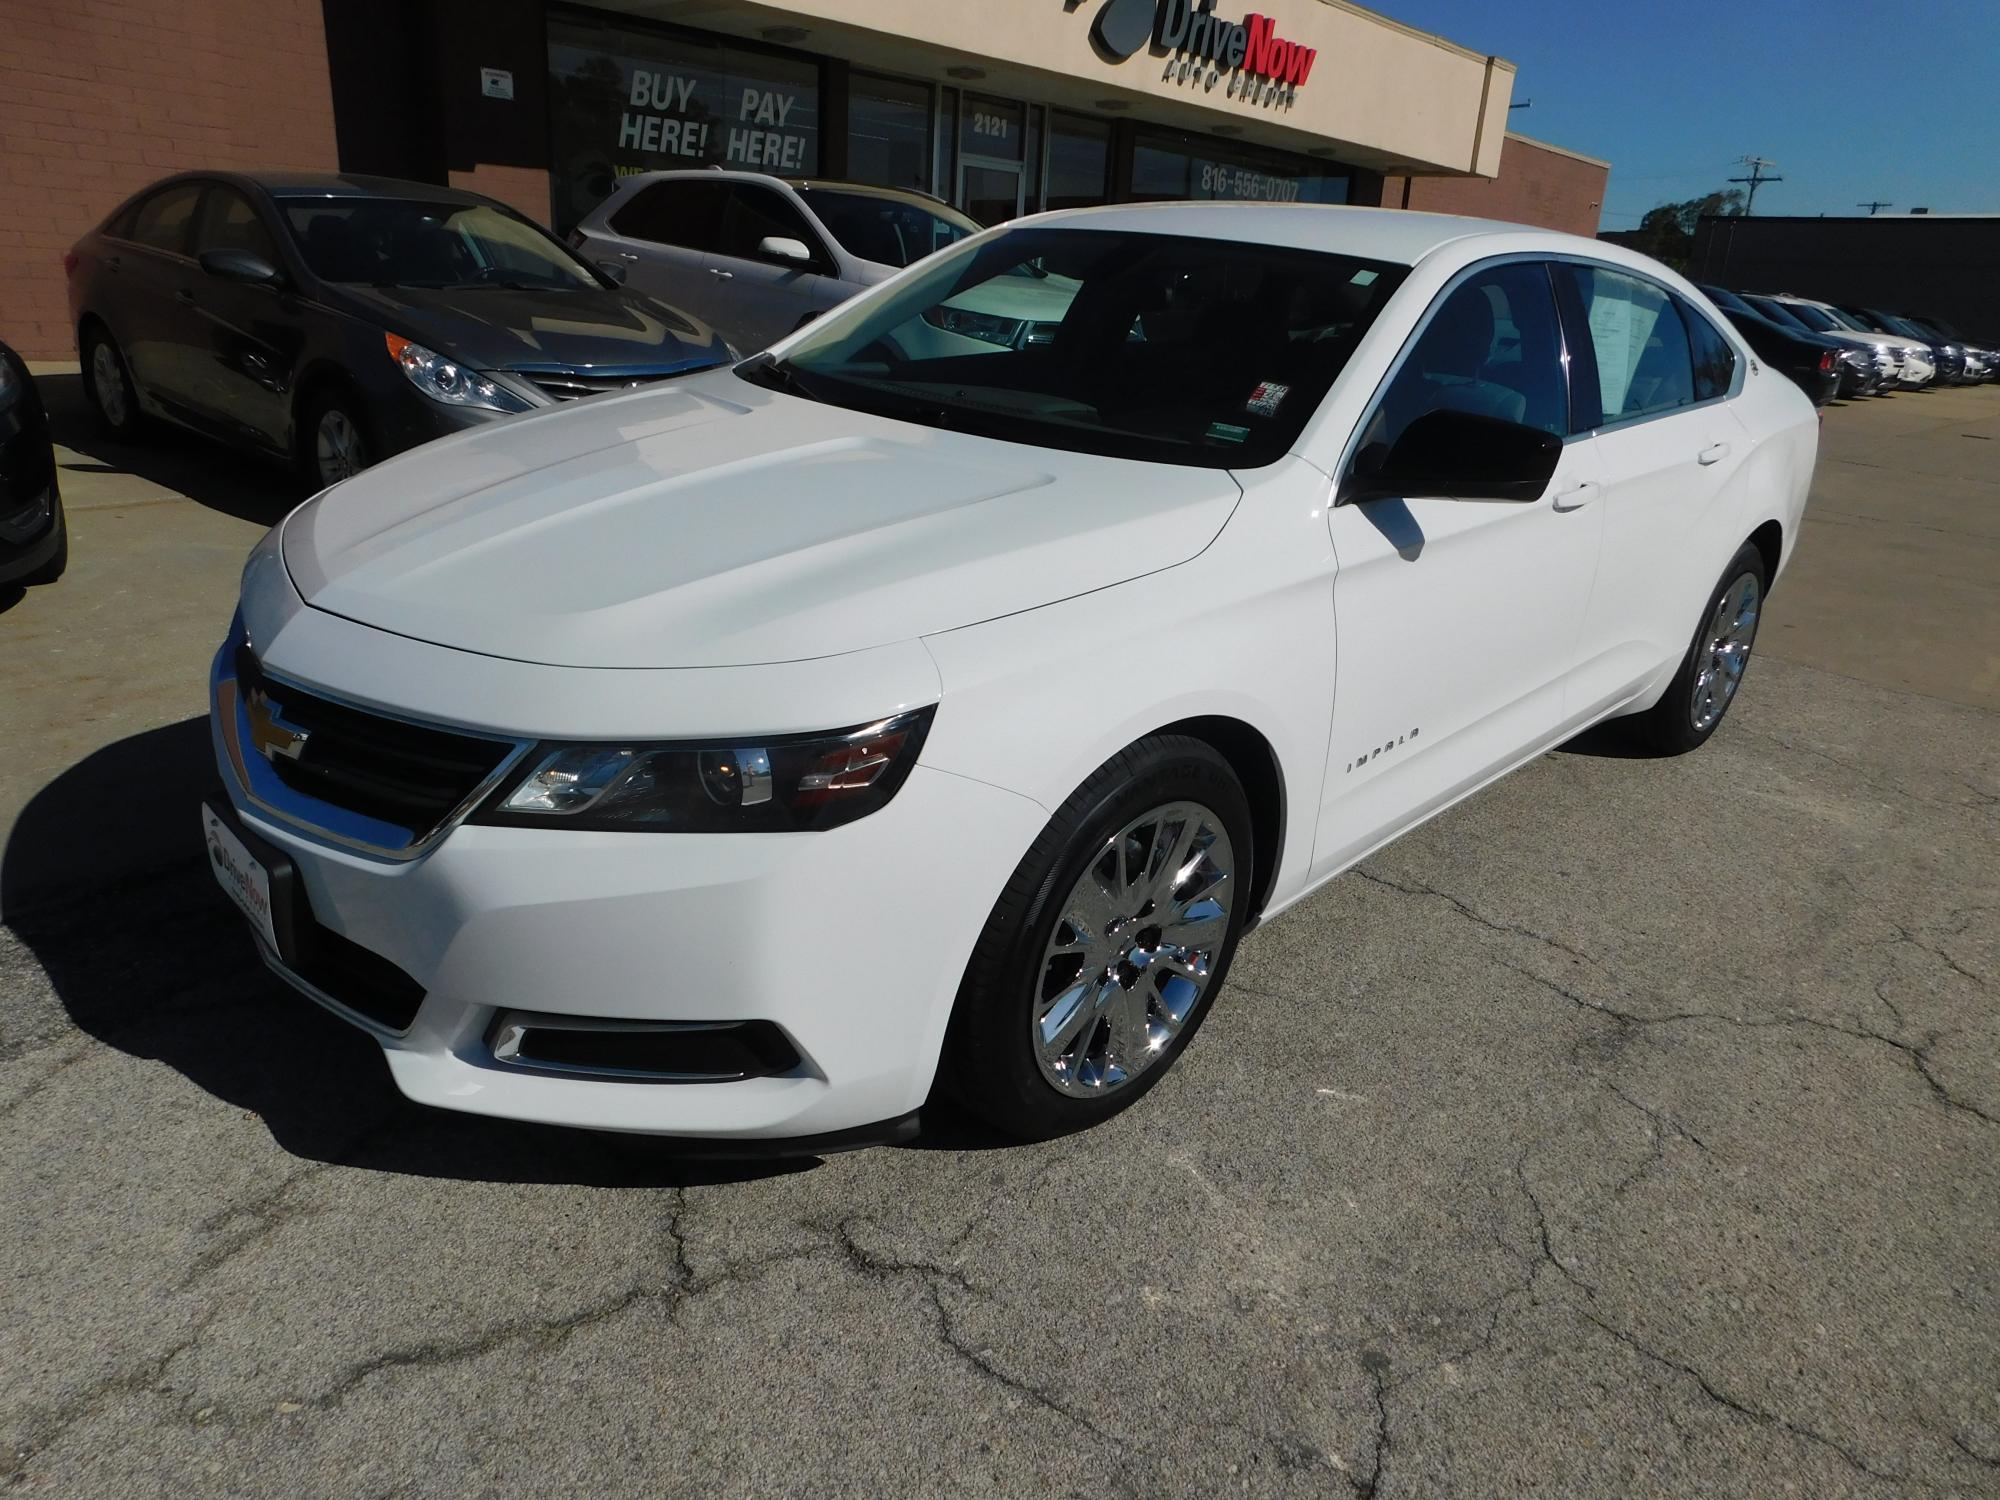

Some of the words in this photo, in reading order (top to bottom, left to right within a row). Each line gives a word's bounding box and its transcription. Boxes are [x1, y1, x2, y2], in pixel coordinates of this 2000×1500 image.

[1160, 0, 1317, 86] DriveNow
[629, 69, 697, 113] BUY
[1168, 58, 1220, 89] AUTO
[738, 87, 796, 128] PAY
[973, 112, 1008, 139] 2121
[618, 112, 709, 157] HERE!
[726, 126, 807, 169] HERE!
[1201, 164, 1299, 202] 816-556-0707
[1346, 727, 1419, 774] IMPALA
